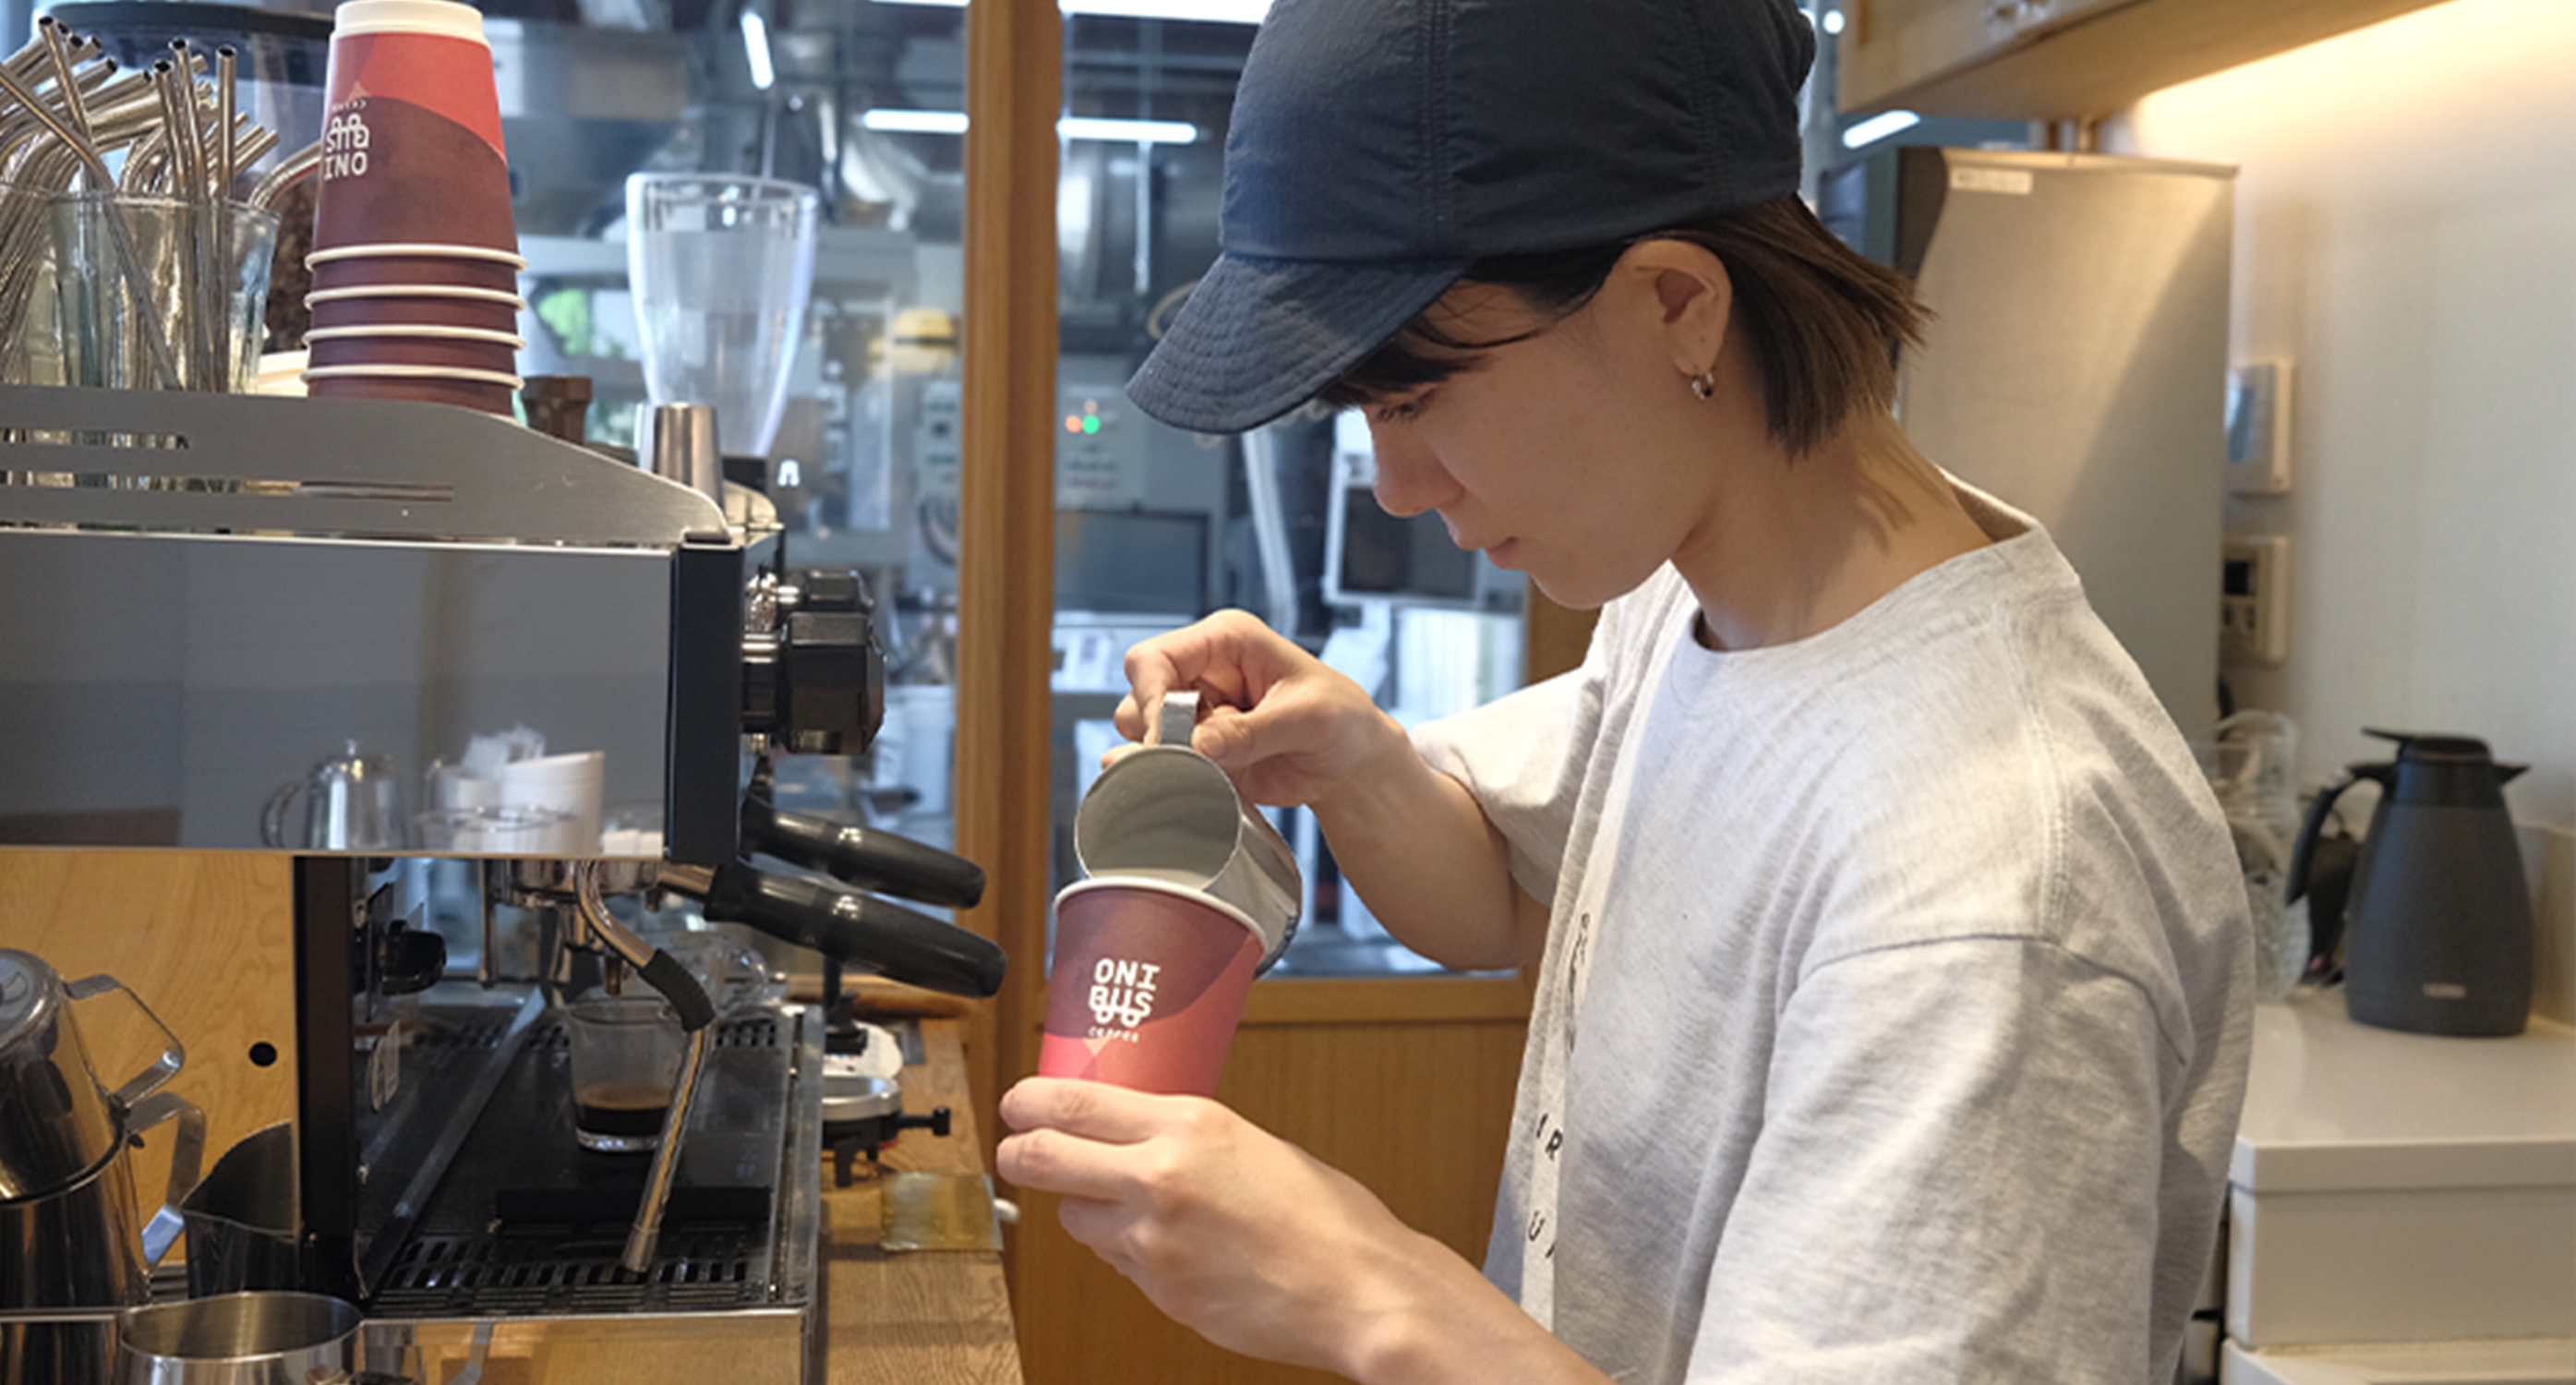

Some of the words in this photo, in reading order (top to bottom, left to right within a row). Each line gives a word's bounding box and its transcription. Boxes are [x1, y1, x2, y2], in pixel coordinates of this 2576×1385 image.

[326, 113, 369, 153] BUS
[324, 151, 367, 181] ONI
[1094, 957, 1161, 992] ONI
[1089, 984, 1153, 1028] BUS
